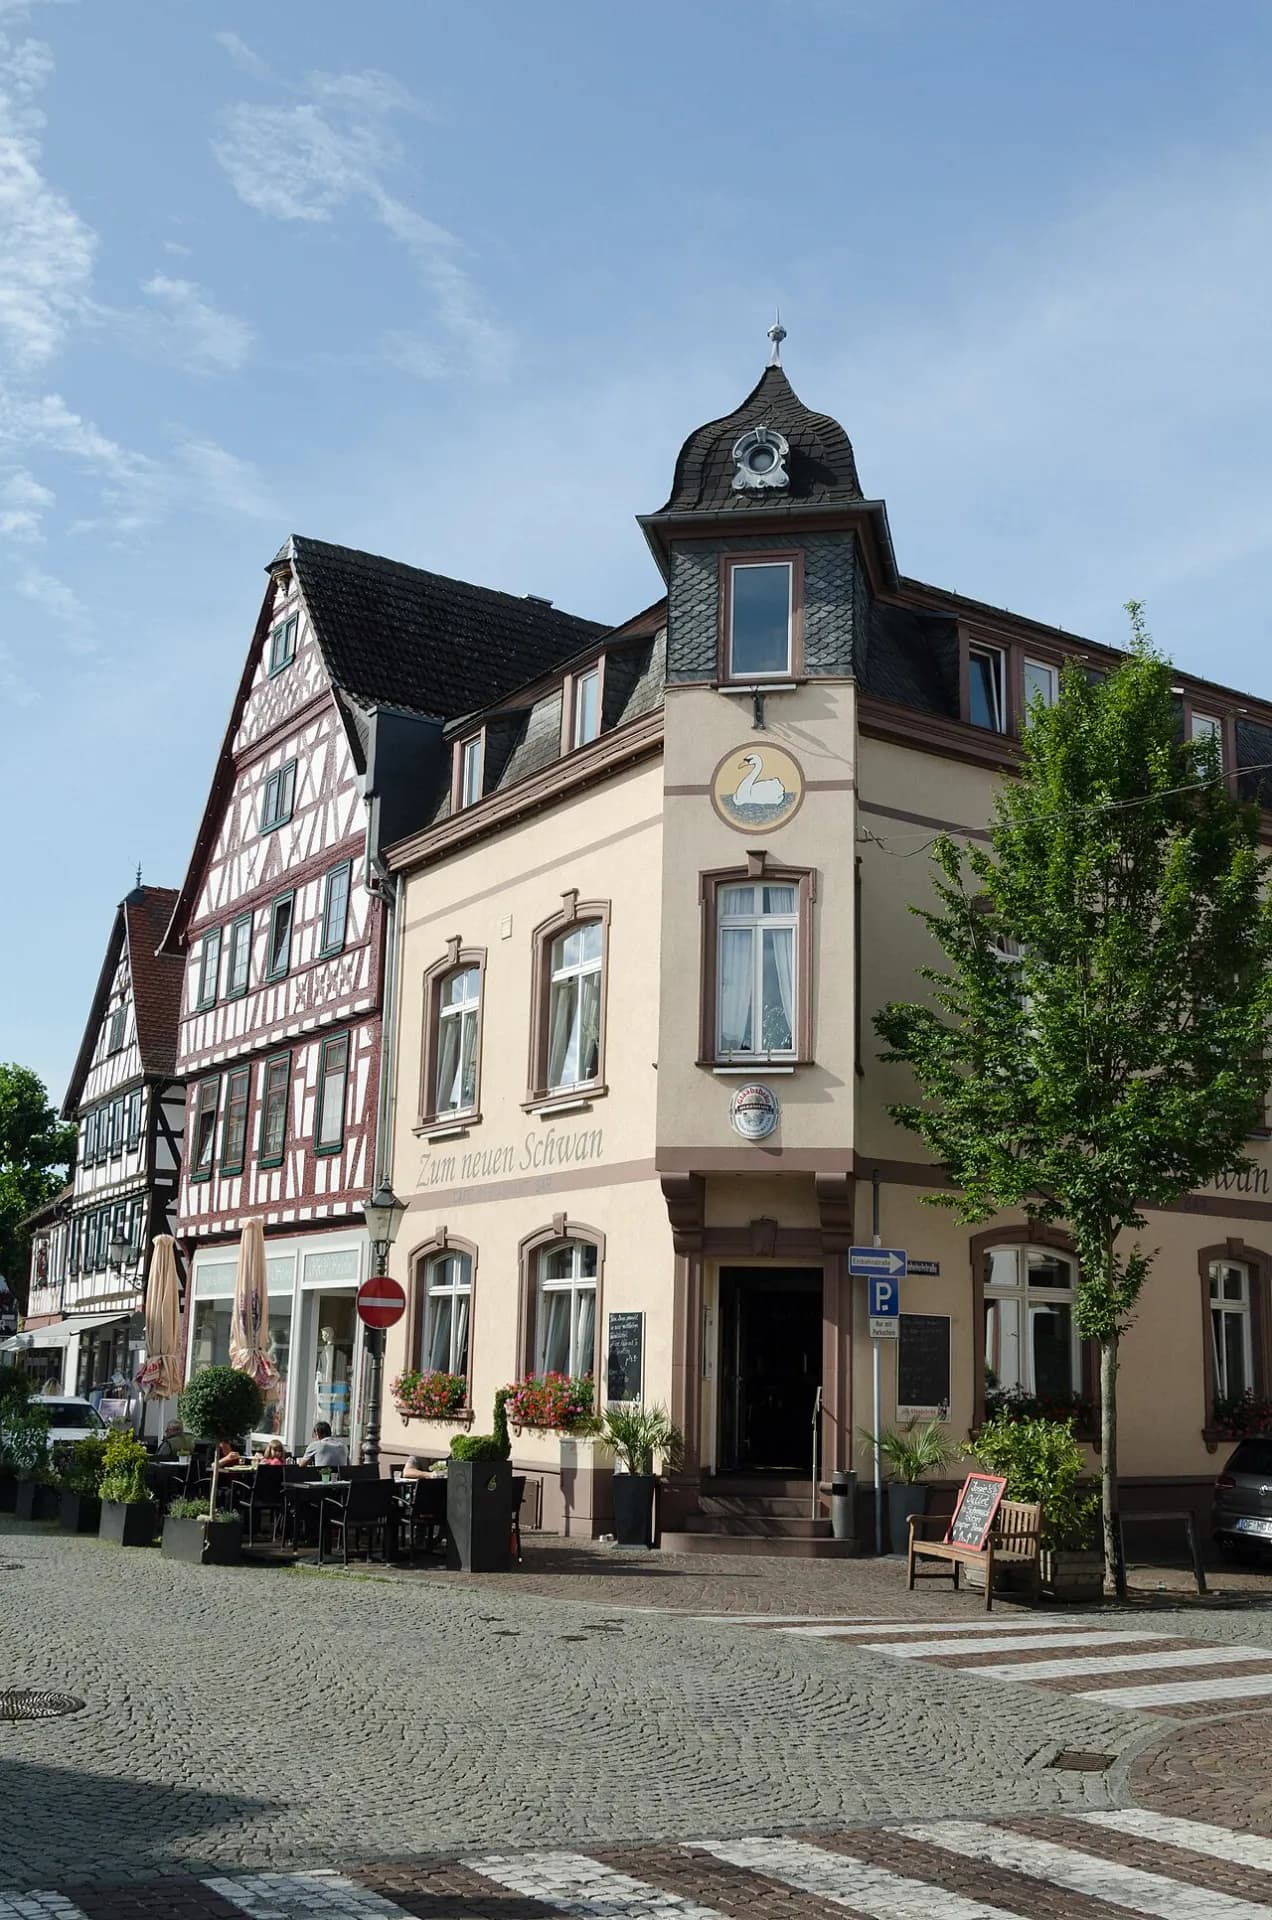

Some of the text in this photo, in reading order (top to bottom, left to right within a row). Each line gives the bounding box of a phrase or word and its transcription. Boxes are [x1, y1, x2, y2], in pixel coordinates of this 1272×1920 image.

[416, 1128, 604, 1188] Zum neuen Schwan
[875, 1282, 892, 1311] P
